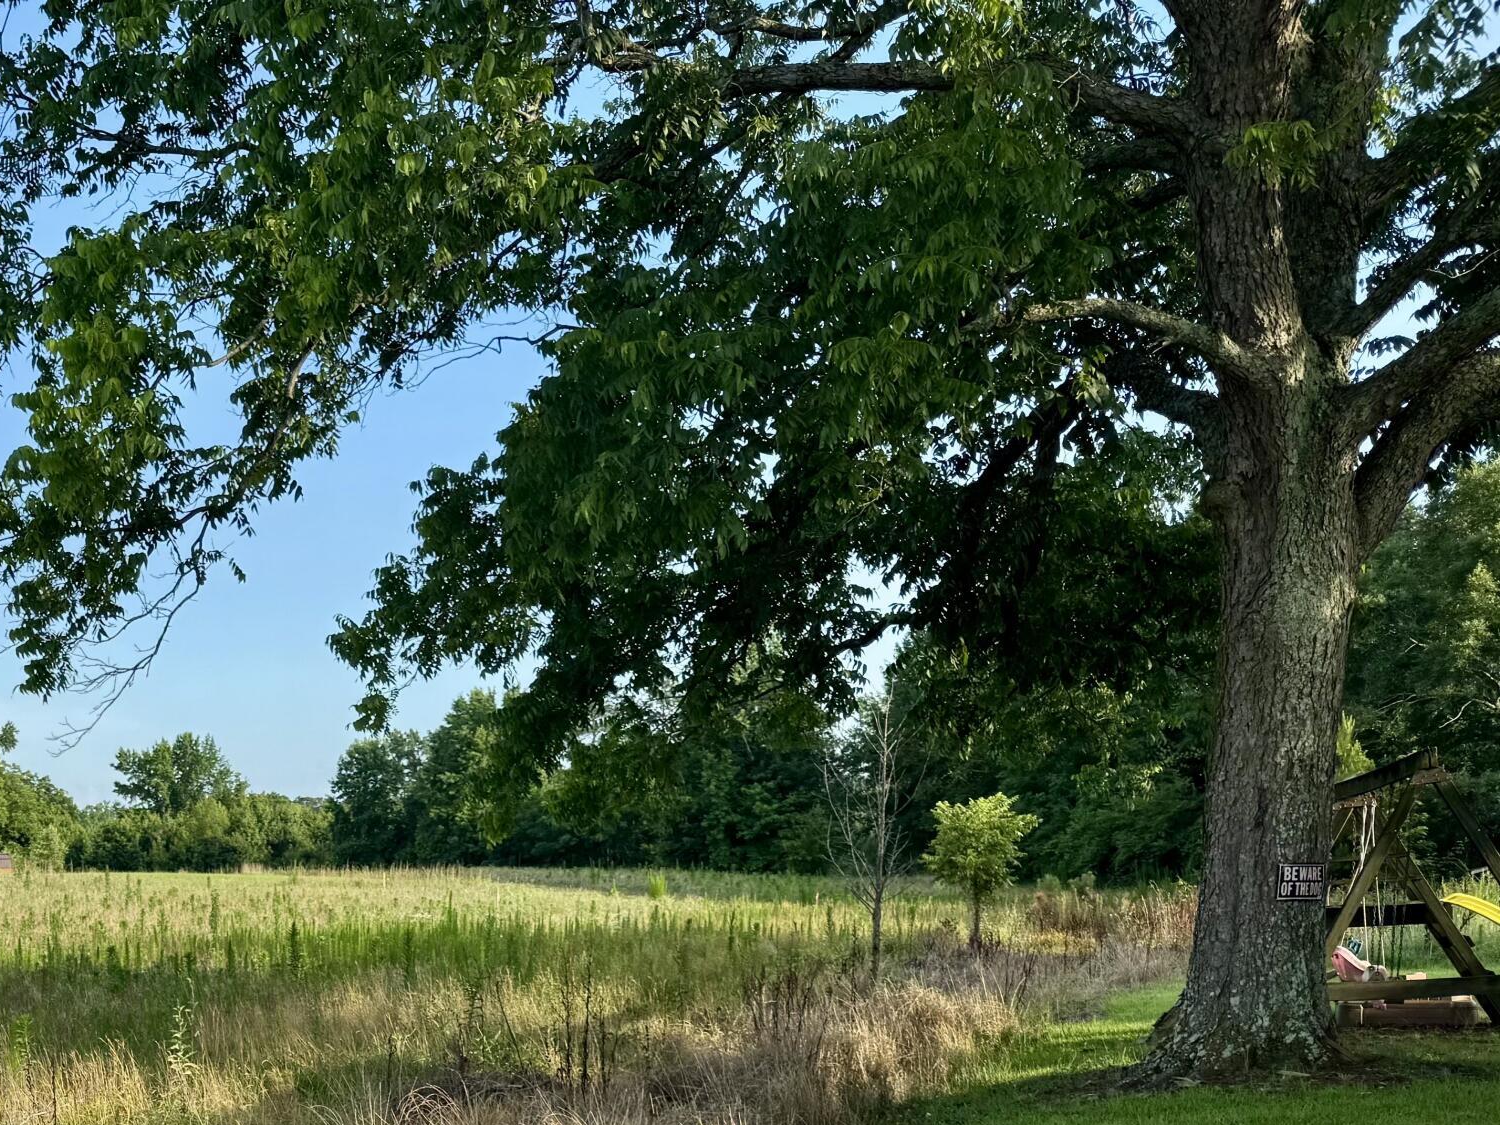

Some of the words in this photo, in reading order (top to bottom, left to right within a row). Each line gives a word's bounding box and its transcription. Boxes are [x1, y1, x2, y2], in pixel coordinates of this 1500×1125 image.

[1284, 867, 1322, 881] BEWARE
[1281, 882, 1293, 896] OF
[1295, 882, 1309, 896] THE
